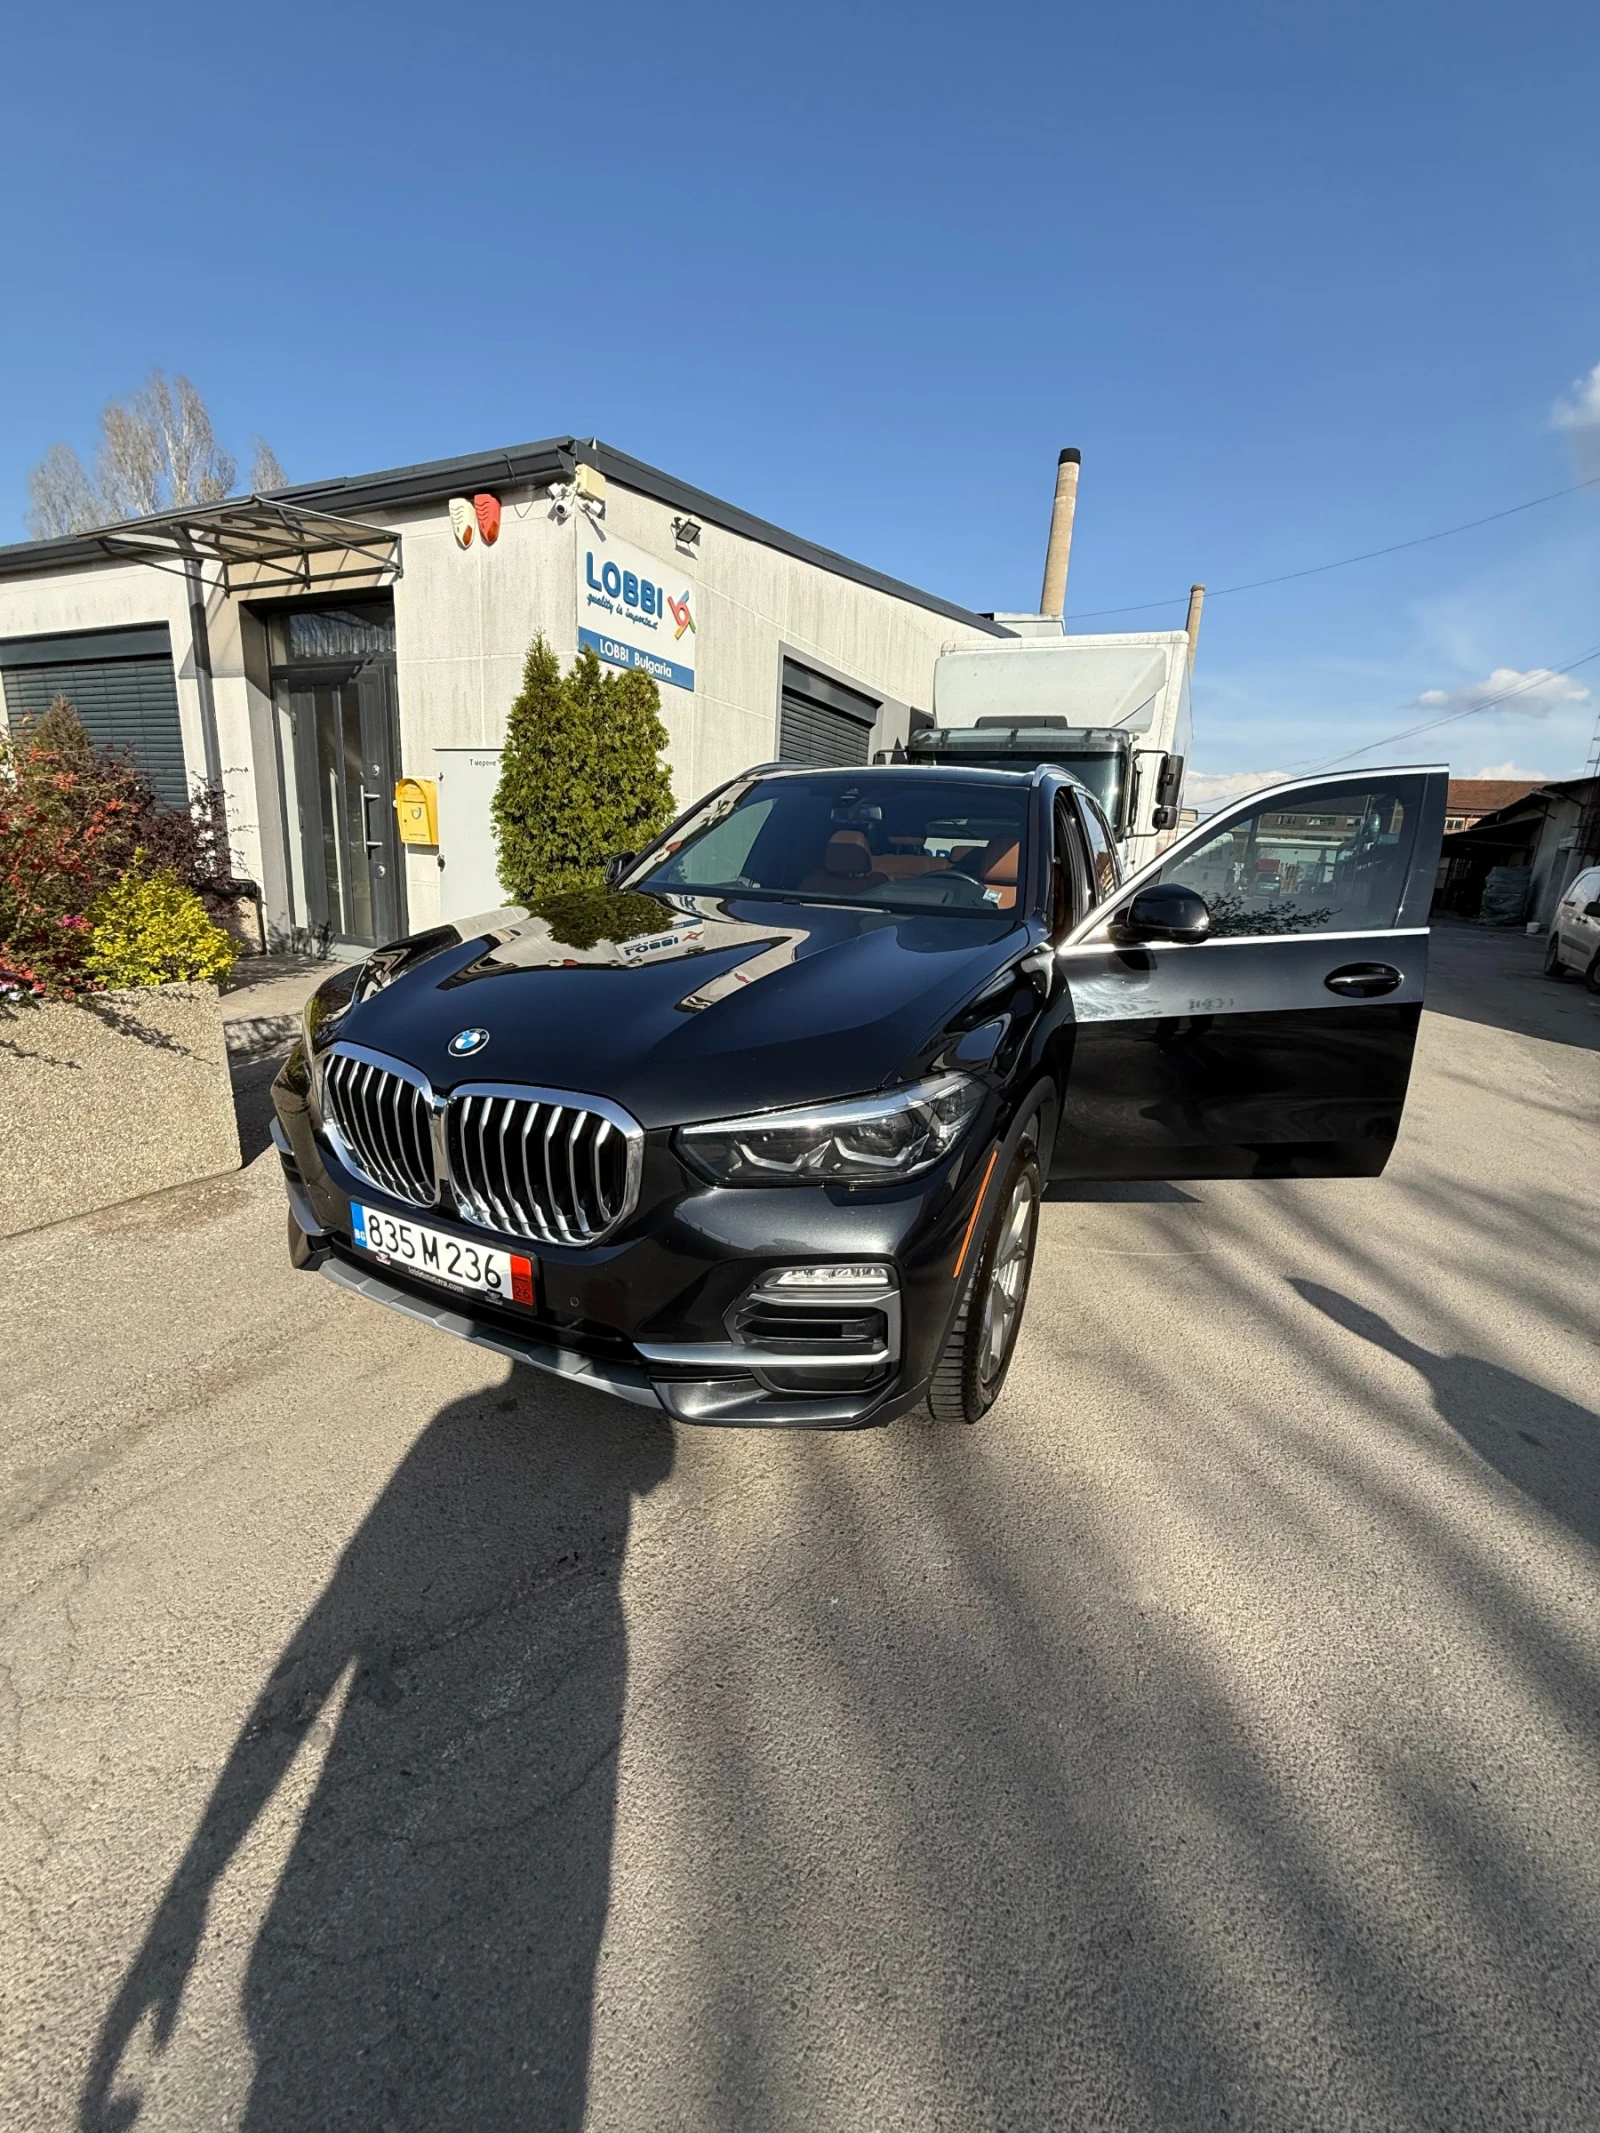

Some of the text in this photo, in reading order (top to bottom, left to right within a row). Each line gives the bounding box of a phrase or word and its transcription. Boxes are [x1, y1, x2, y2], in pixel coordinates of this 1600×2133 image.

[586, 551, 663, 620] LOBBI
[587, 593, 614, 615] quality
[616, 604, 623, 615] is
[600, 639, 672, 679] LOBBI Bulgaria
[354, 1227, 366, 1242] BG
[368, 1214, 502, 1289] 835 M 236
